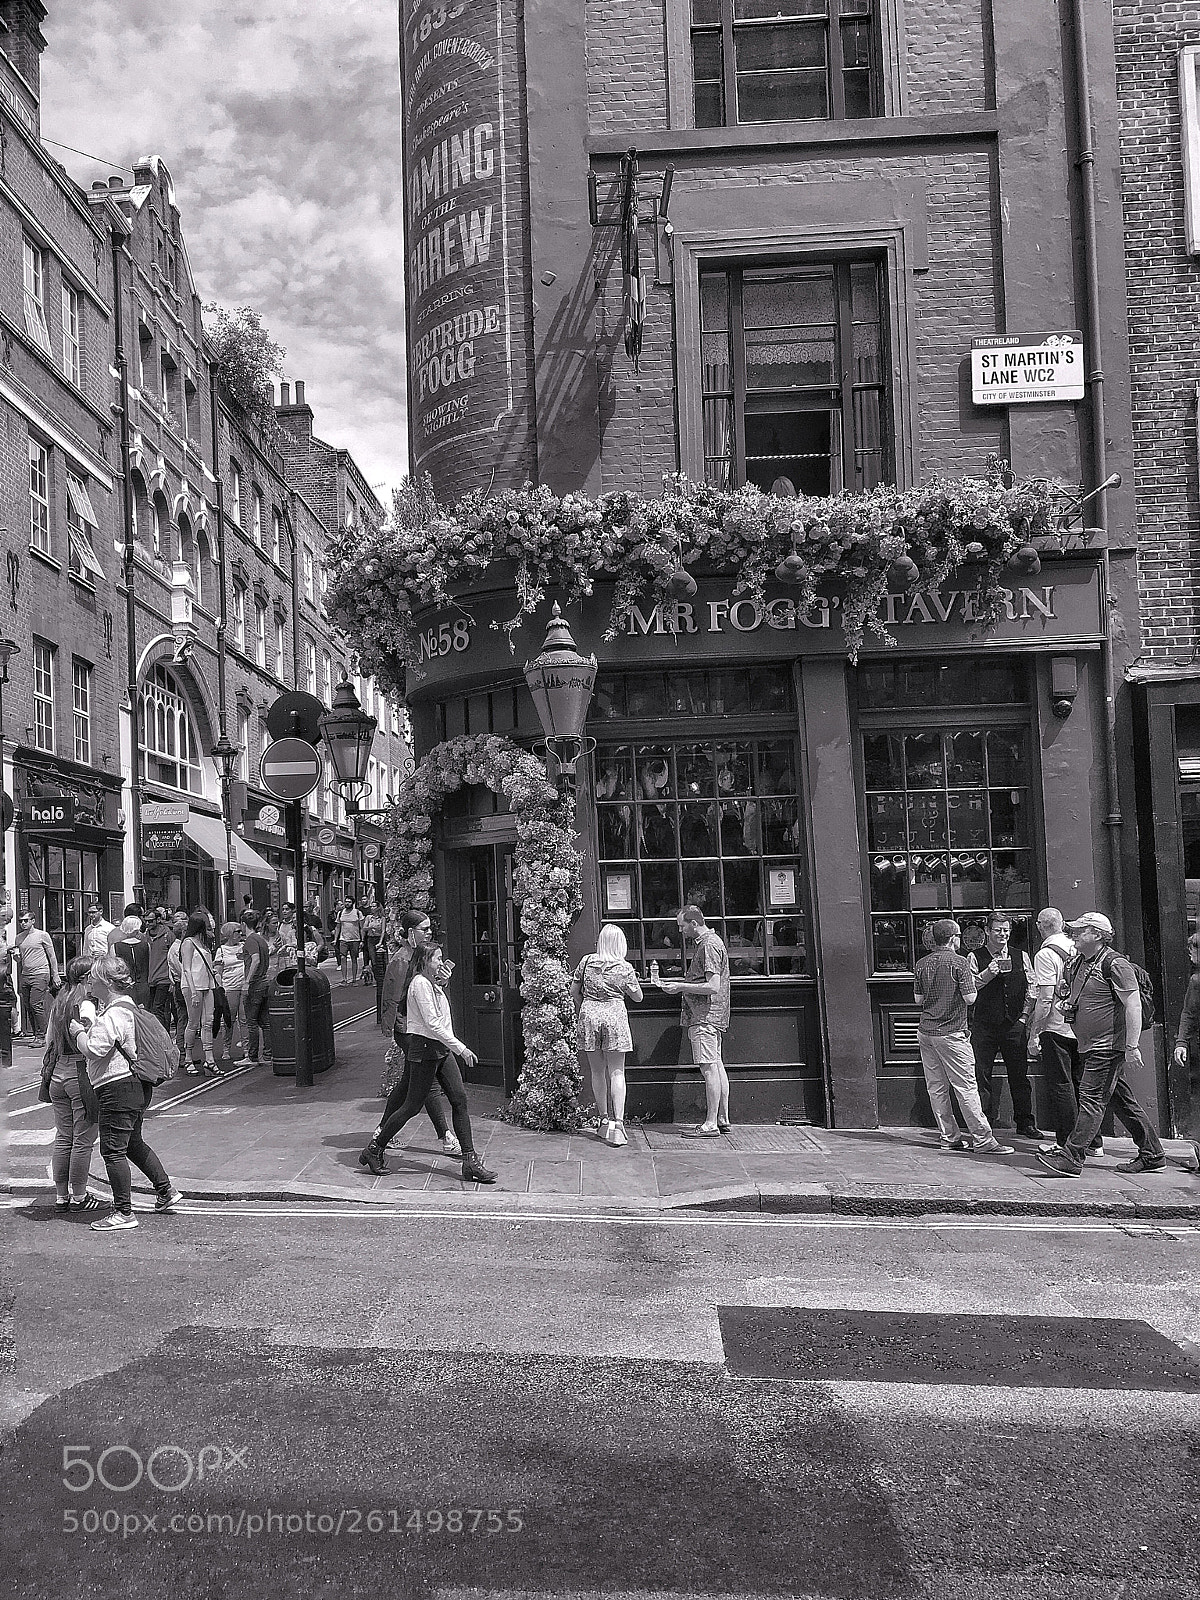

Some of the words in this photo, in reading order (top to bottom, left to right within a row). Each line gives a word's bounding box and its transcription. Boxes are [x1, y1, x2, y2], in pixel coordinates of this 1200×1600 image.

[421, 212, 433, 230] OF
[433, 197, 457, 220] THE
[975, 337, 1020, 346] THEATRELAND
[982, 354, 998, 368] ST
[1004, 350, 1074, 367] MARTIN'S
[419, 341, 477, 403] FOGG
[982, 370, 1018, 385] LANE
[1024, 368, 1055, 382] WC2
[982, 392, 997, 400] CITY
[998, 392, 1007, 400] OF
[1009, 390, 1056, 399] WESTMINSTER
[627, 601, 698, 636] MR
